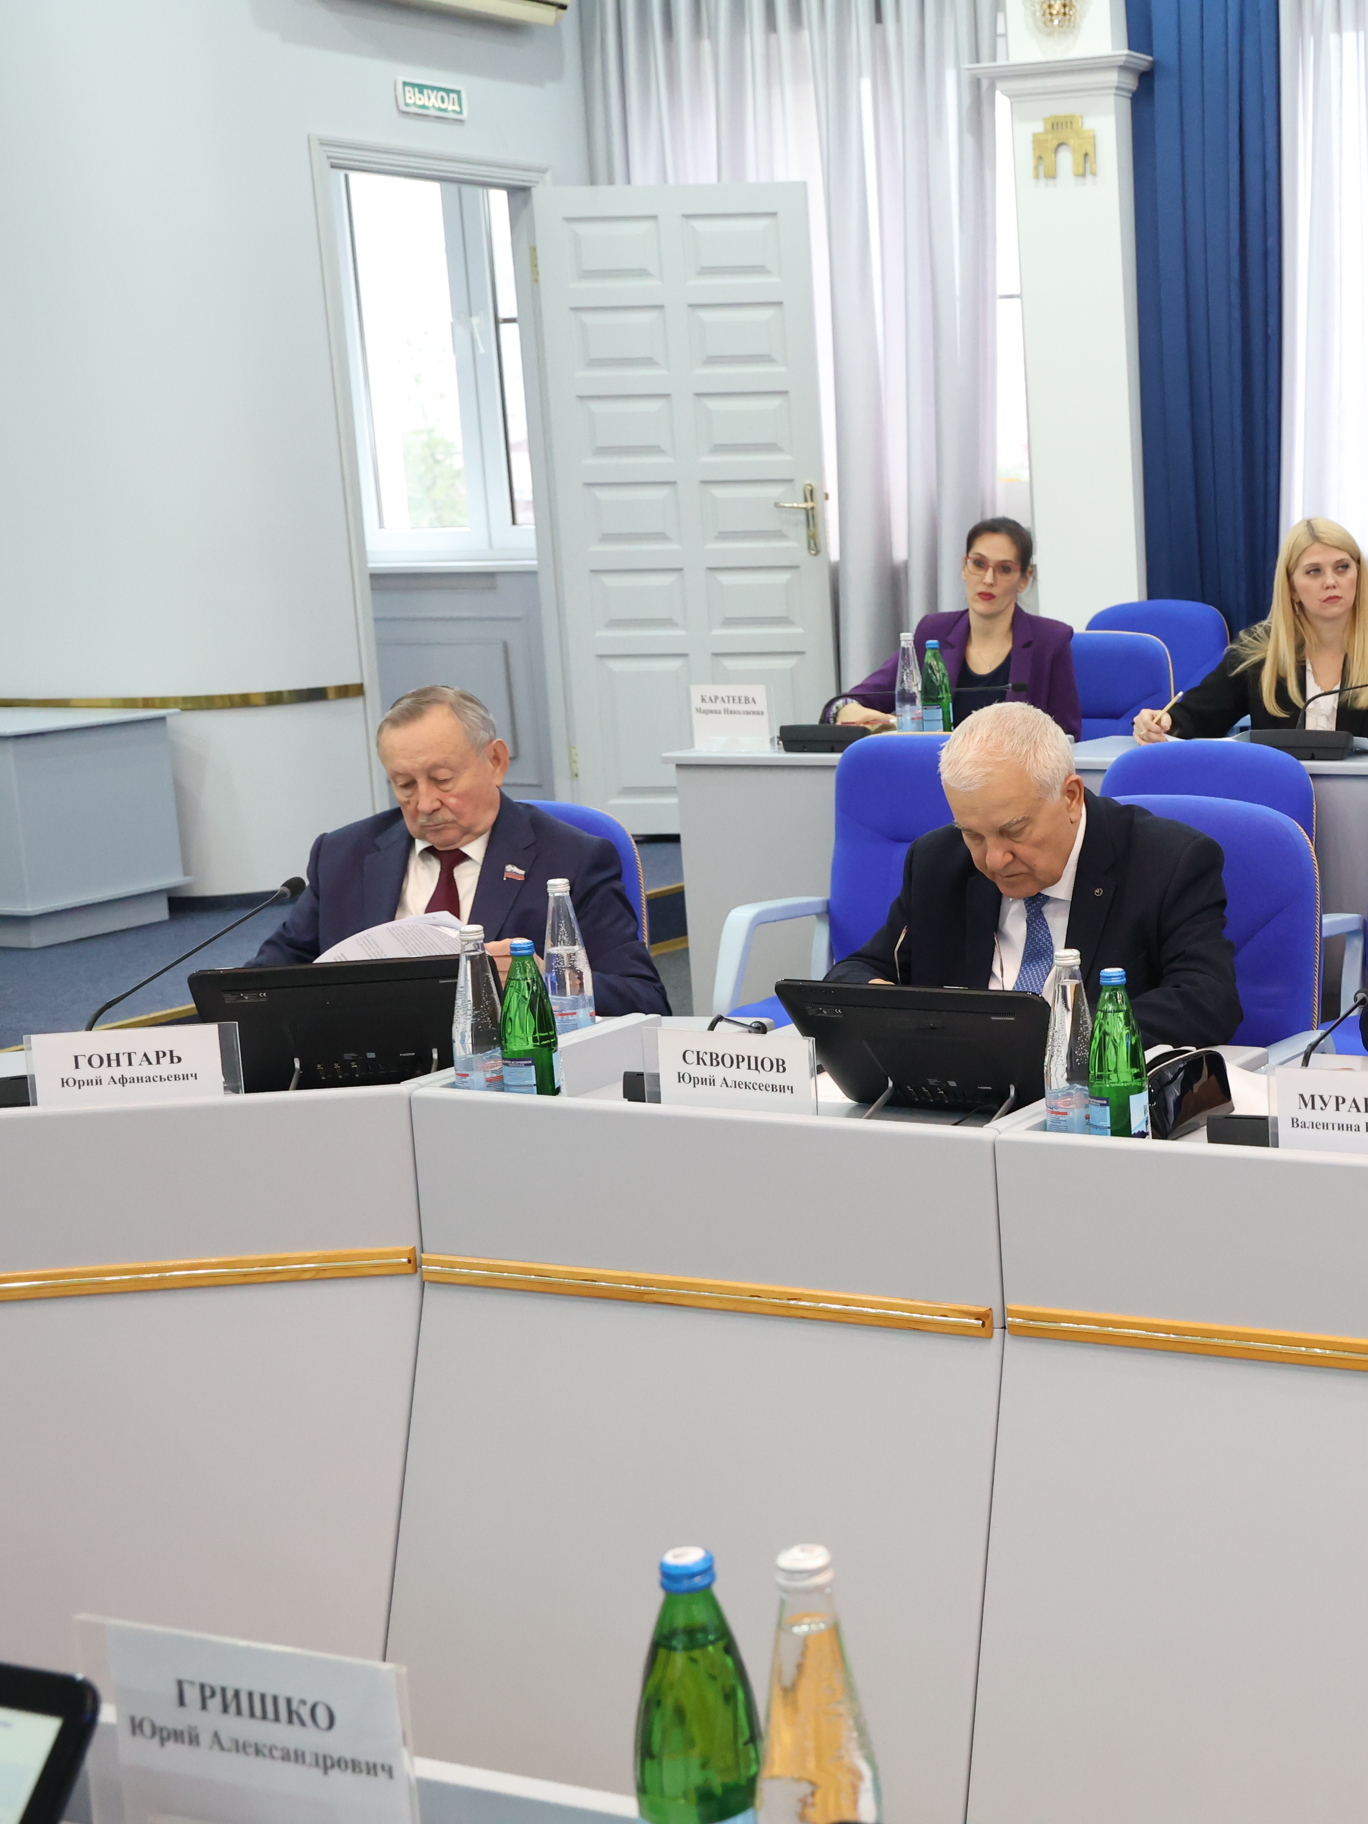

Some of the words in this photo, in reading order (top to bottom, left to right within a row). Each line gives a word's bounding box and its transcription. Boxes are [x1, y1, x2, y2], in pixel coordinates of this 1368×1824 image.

[404, 86, 461, 112] ВЫХОД
[700, 694, 757, 705] КАРАТЕЕВА
[72, 1049, 183, 1070] ГОНТАРЬ
[682, 1049, 787, 1075] СКВОРЦОВ
[60, 1075, 104, 1090] Юрий
[107, 1072, 198, 1088] Афанасьевич
[676, 1071, 716, 1088] Юрий
[720, 1076, 795, 1094] Алексеевич
[1290, 1116, 1361, 1133] Валентина
[175, 1678, 336, 1732] ГРИШКО
[128, 1714, 201, 1748] Юрий
[208, 1729, 395, 1780] Александрович
